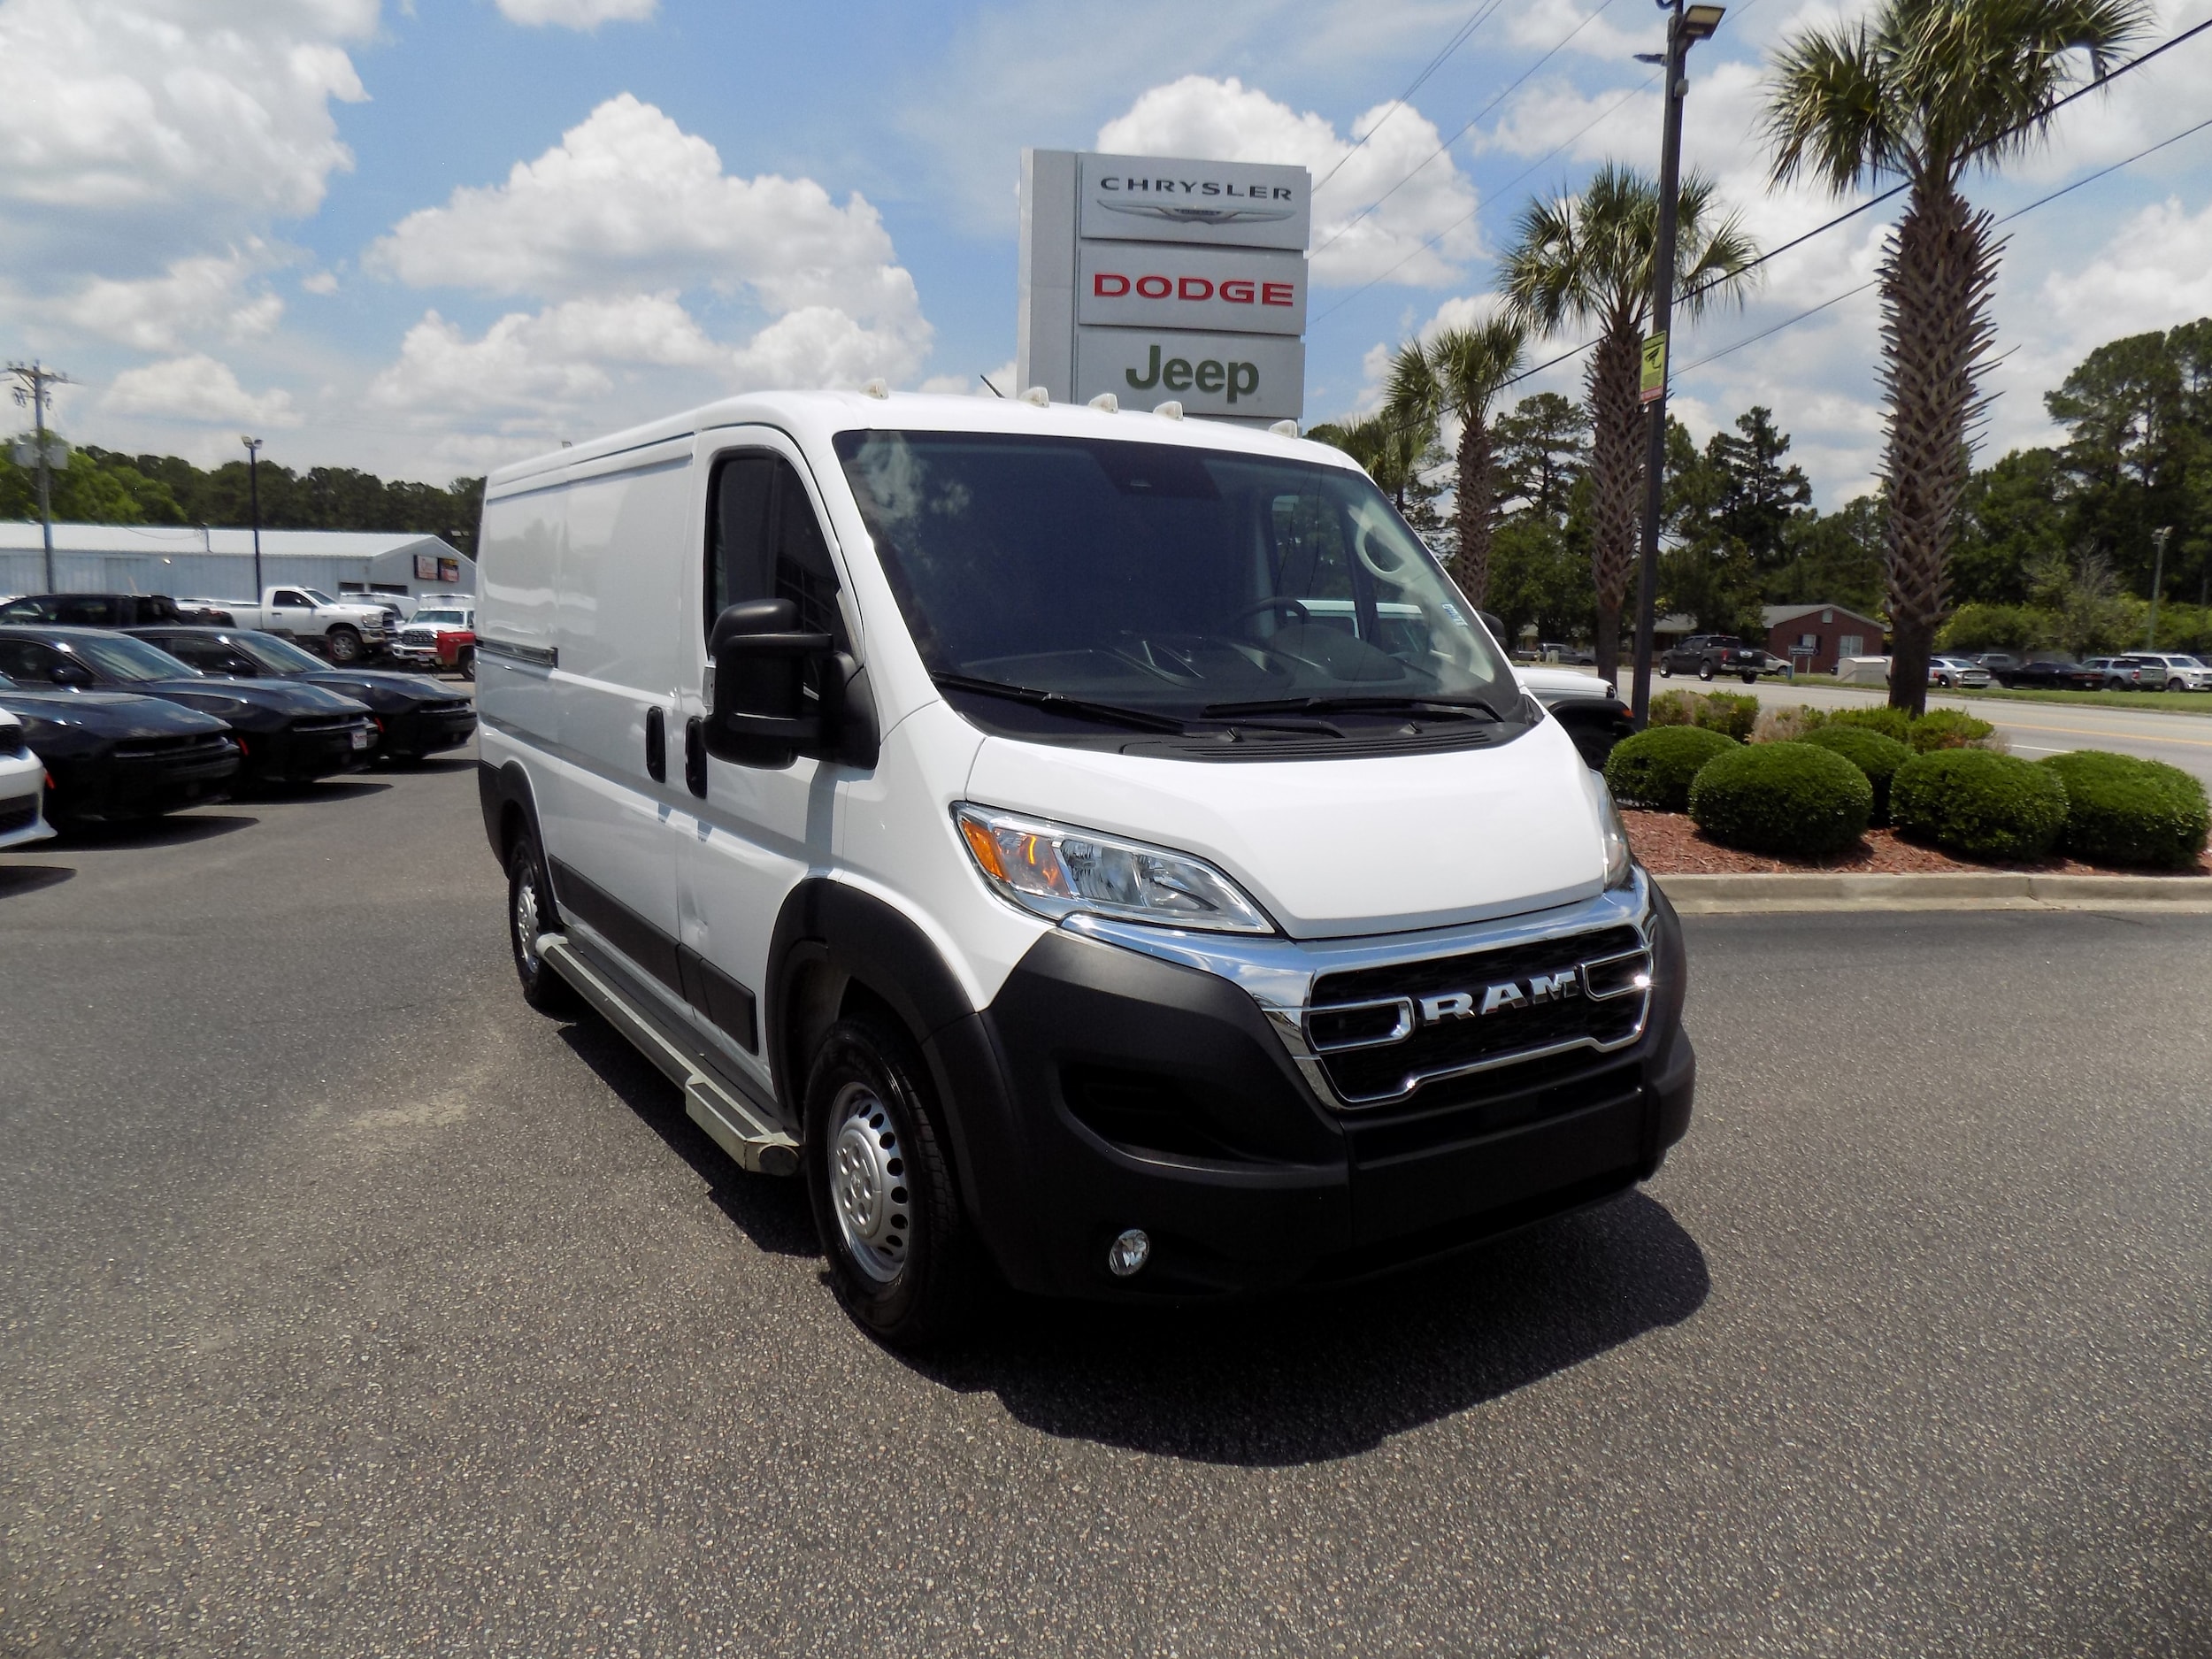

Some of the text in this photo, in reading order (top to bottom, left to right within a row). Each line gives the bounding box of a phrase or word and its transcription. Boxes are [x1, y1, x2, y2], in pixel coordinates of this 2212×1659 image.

[1100, 177, 1293, 202] CHRYSLER
[1094, 273, 1294, 307] DODGE
[1125, 344, 1260, 403] Jeep
[1418, 970, 1580, 1027] RAM
